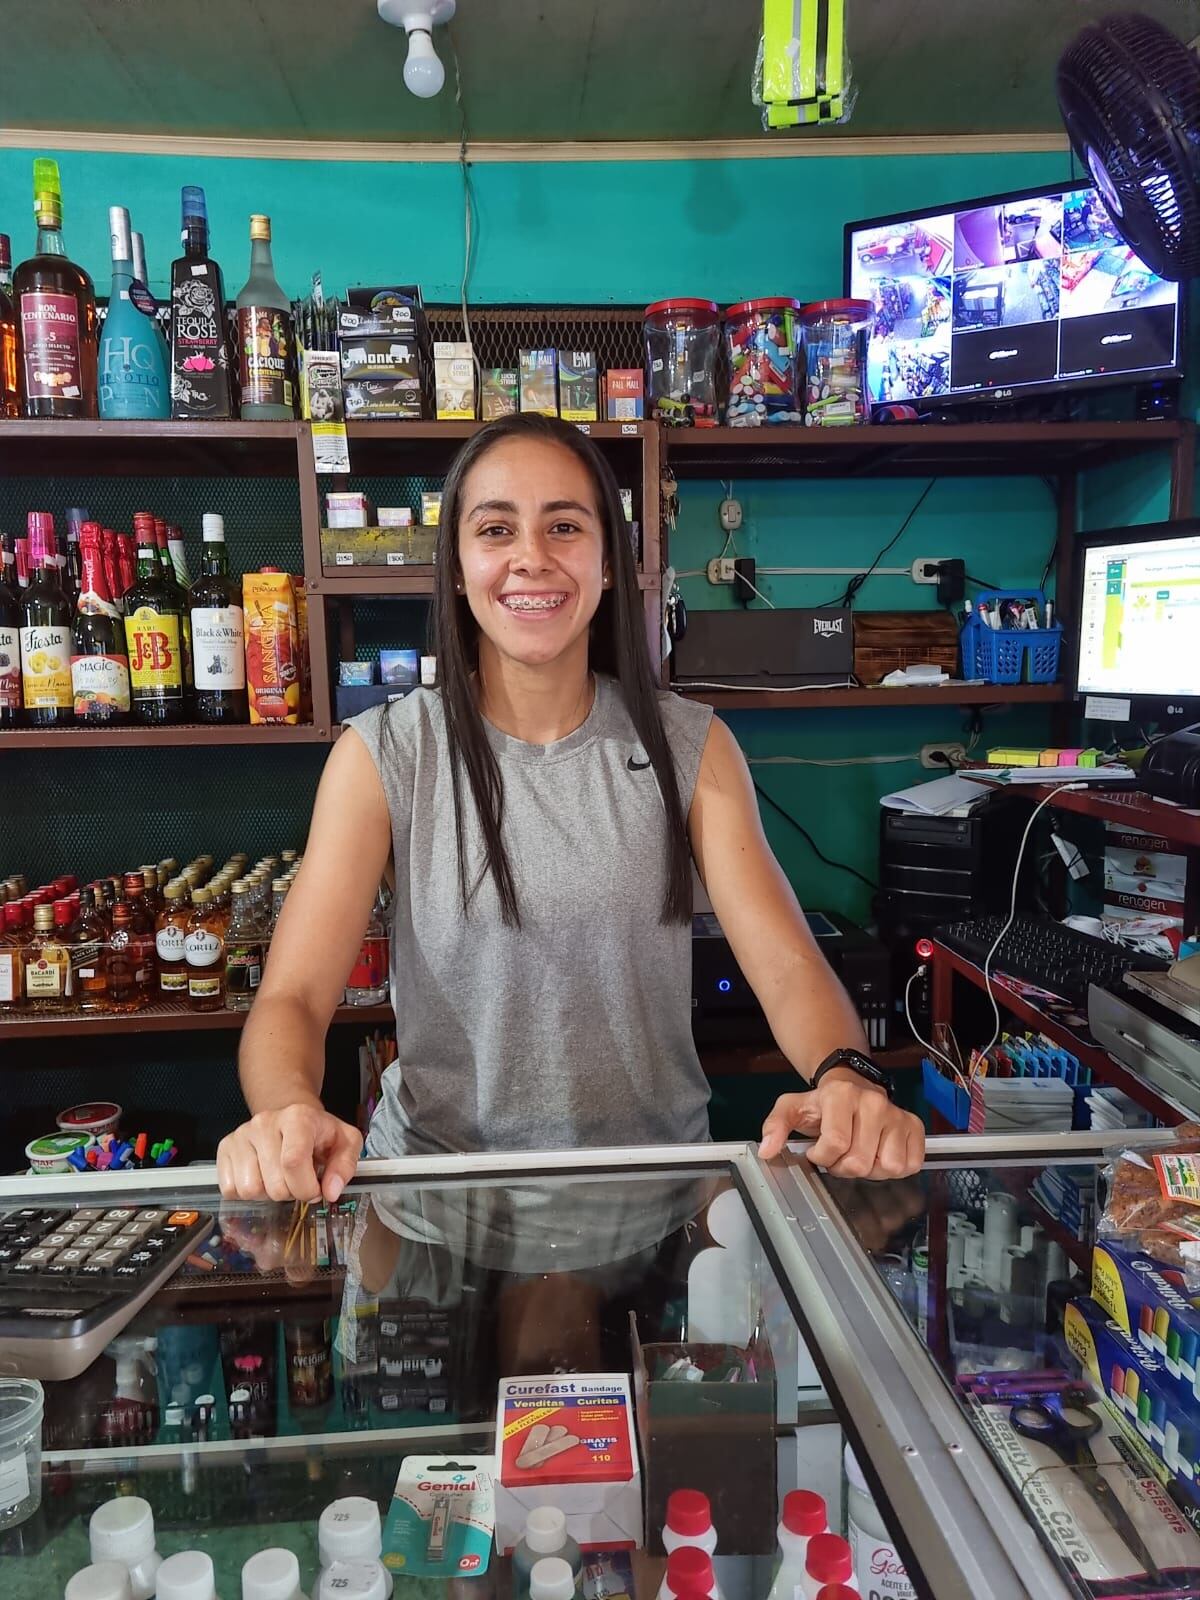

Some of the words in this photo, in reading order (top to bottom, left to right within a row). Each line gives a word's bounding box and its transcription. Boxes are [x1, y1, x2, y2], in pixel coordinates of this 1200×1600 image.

[38, 304, 57, 313] RON
[23, 311, 76, 322] CENTENARIO
[395, 310, 410, 318] 700
[176, 316, 217, 327] TEQUILA
[177, 324, 218, 339] ROSE
[248, 356, 285, 370] CACIQUE
[612, 380, 624, 390] PALL
[626, 380, 640, 390] MALL
[813, 617, 844, 635] EVERLAST
[196, 627, 215, 638] Black
[215, 630, 222, 638] &
[25, 629, 62, 653] Fiesta
[132, 631, 173, 671] J&B
[1121, 834, 1170, 850] renogen
[1117, 893, 1168, 912] renogen
[109, 1210, 130, 1219] 00
[145, 1211, 158, 1220] 0
[64, 1222, 80, 1231] 3
[97, 1222, 112, 1232] 2
[130, 1223, 140, 1233] 1
[51, 1235, 65, 1244] 6
[82, 1236, 97, 1245] 5
[113, 1237, 129, 1246] 4
[31, 1250, 46, 1259] 9
[64, 1250, 80, 1260] 8
[96, 1250, 112, 1261] 7
[1147, 1271, 1195, 1311] Pelikan
[506, 1383, 576, 1396] Curefast
[581, 1385, 623, 1394] Bandage
[513, 1400, 565, 1408] Venditas
[576, 1398, 620, 1406] Curitas
[591, 1454, 611, 1462] 110
[417, 1481, 476, 1491] Genial
[988, 1410, 1032, 1468] Beauty
[1050, 1510, 1091, 1565] Care
[1141, 1480, 1187, 1535] Scissors
[334, 1512, 351, 1521] 725
[331, 1578, 350, 1588] 725
[881, 1579, 903, 1590] ACEITE
